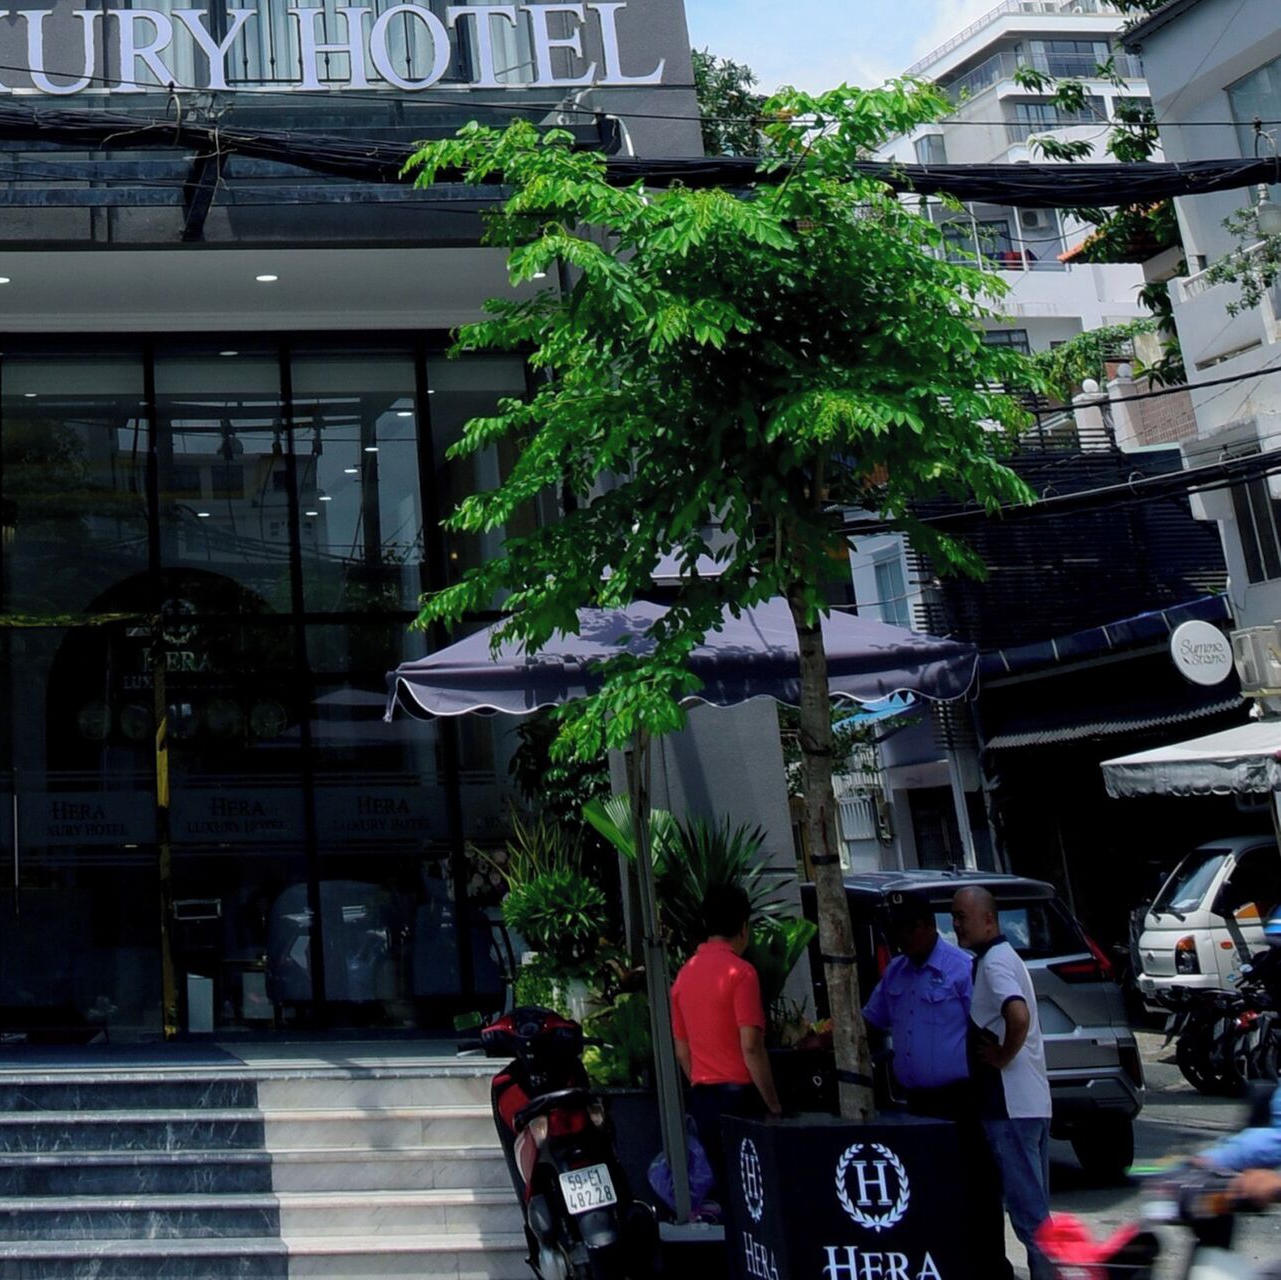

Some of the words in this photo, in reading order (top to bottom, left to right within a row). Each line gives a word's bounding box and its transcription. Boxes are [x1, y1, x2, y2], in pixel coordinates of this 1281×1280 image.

[295, 1, 666, 91] HOTEL
[568, 1168, 602, 1191] 59-E1
[570, 1185, 613, 1210] 482.28
